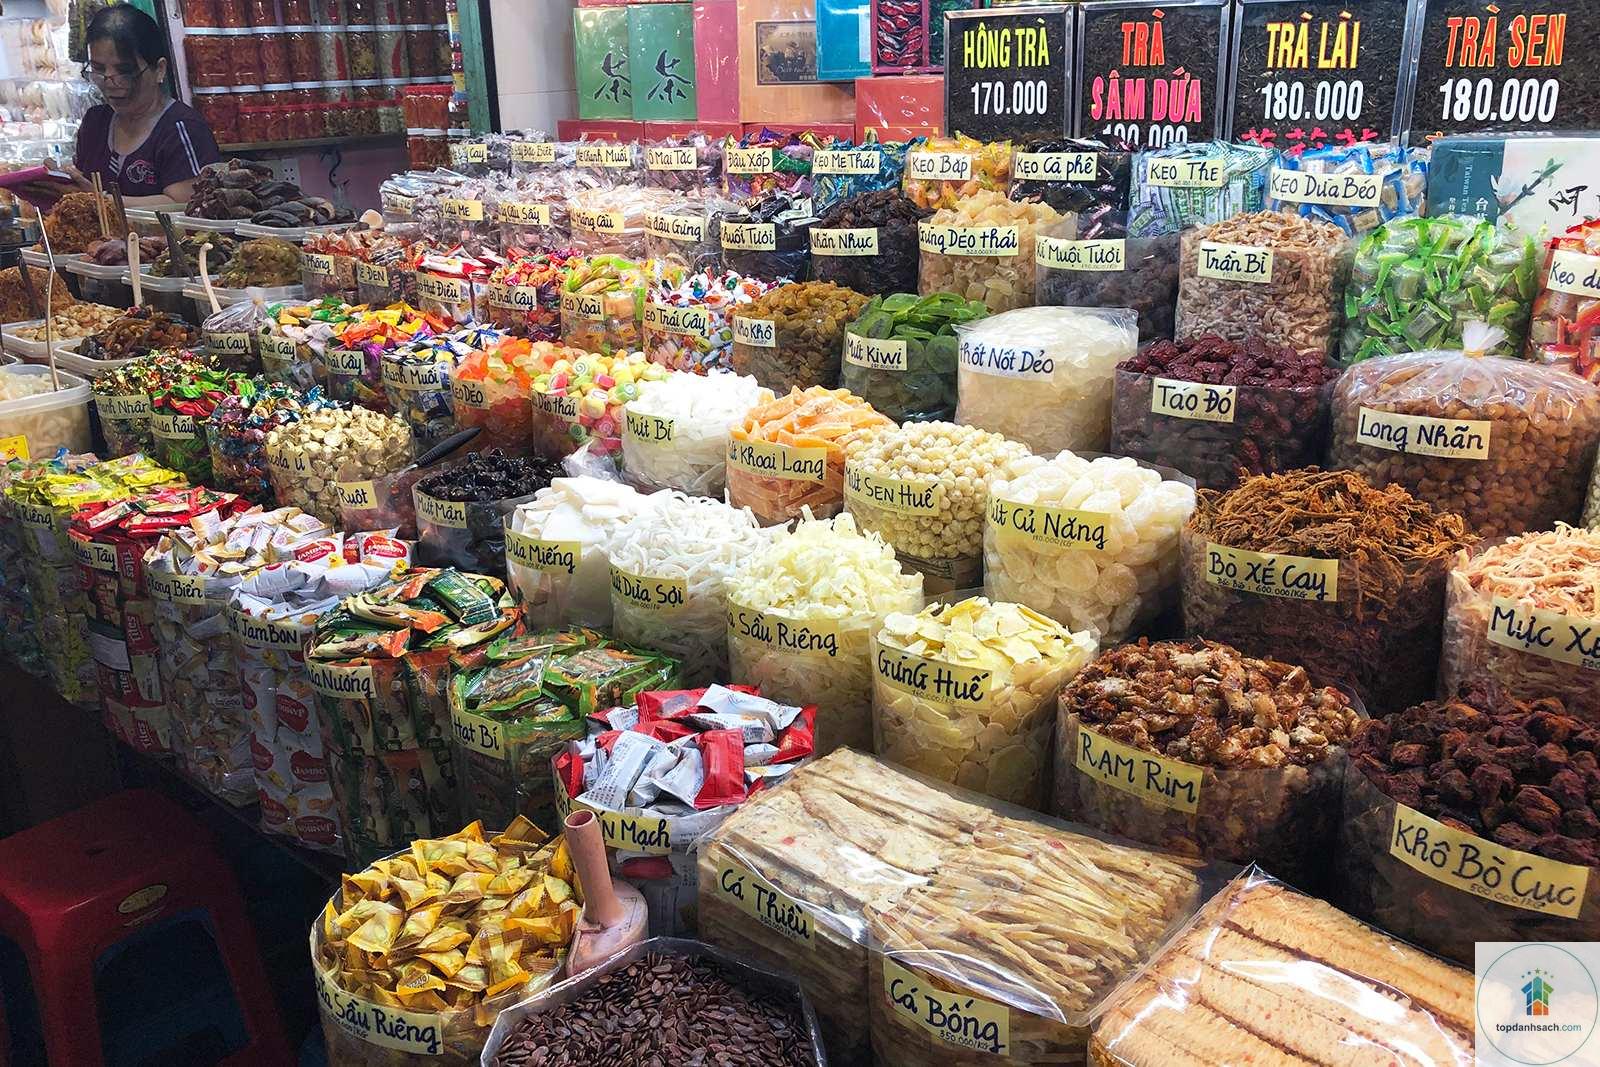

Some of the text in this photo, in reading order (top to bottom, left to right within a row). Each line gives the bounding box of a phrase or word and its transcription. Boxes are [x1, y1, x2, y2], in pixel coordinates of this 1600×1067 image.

[1015, 18, 1050, 68] TRÀ
[1121, 8, 1166, 66] TRÀ
[1266, 11, 1360, 69] TRÀ LÀI
[1445, 4, 1567, 68] TRÀ SEN
[971, 80, 1048, 115] 170.000
[1091, 66, 1202, 122] SÂM DỨA
[1261, 80, 1364, 121] 180.000
[1439, 78, 1560, 123] 180.000
[1066, 155, 1095, 181] phê
[1342, 175, 1377, 200] Béo
[838, 231, 873, 252] Nhục
[980, 228, 1018, 250] thái
[514, 291, 534, 311] Cây
[657, 307, 680, 329] Trái
[681, 311, 706, 336] Cây
[749, 325, 773, 341] Khô
[341, 353, 362, 374] Cây
[867, 346, 902, 366] Kiwi
[988, 344, 1016, 371] Nốt
[1158, 385, 1198, 412] Táo
[654, 419, 674, 442] Bí
[1359, 414, 1484, 453] Long Nhãn
[741, 445, 777, 470] Khoai
[782, 450, 824, 481] Lang
[898, 482, 938, 510] Huế
[1043, 511, 1108, 550] Năng
[529, 544, 575, 574] Miếng
[1209, 551, 1238, 579] Bò
[1282, 564, 1329, 601] Cay
[740, 612, 773, 644] Sầu
[777, 621, 839, 657] Riêng
[1491, 605, 1554, 649] Mực
[324, 670, 374, 698] Nướng
[933, 667, 990, 703] Huế
[478, 725, 500, 751] Bí
[621, 819, 671, 850] Mạch
[1395, 819, 1451, 868] Khô
[1452, 843, 1506, 889] Bò
[722, 868, 745, 902] Cá
[752, 882, 810, 940] Thiều
[335, 992, 371, 1031] Sầu
[371, 1007, 441, 1055] Riêng
[890, 978, 1006, 1054] Cá Bống
